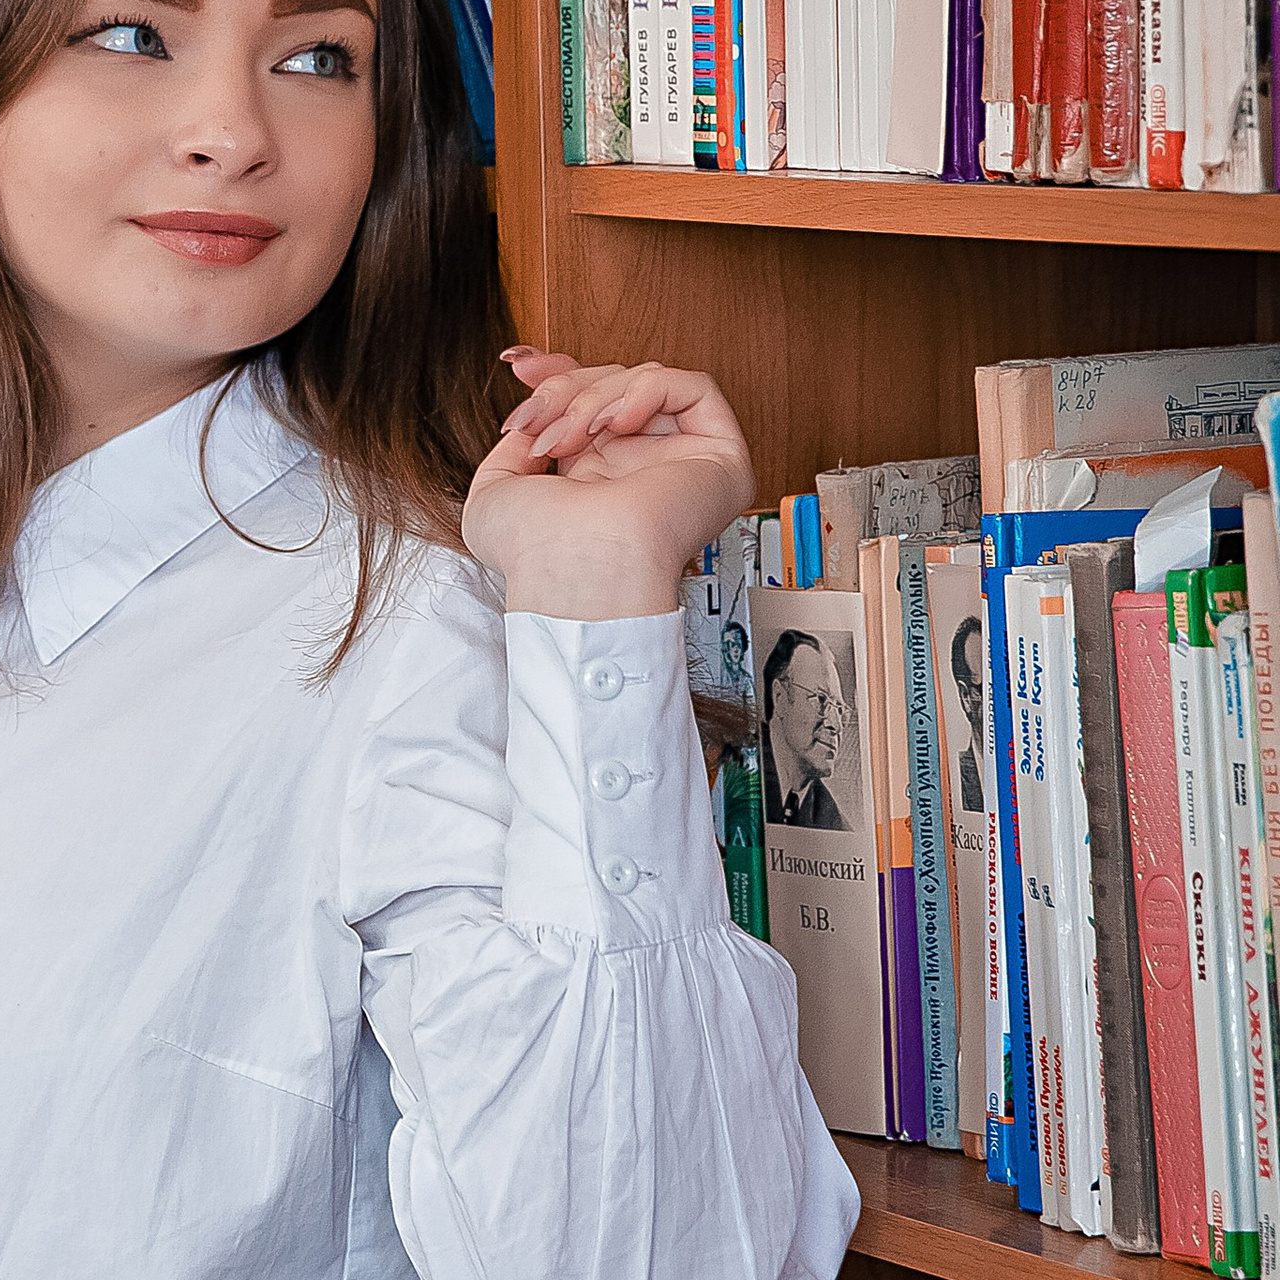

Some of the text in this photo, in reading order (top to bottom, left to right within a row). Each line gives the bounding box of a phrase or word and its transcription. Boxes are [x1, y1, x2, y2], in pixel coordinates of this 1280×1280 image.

[559, 6, 573, 131] ХРЕСТОМАТИЯ
[1150, 85, 1166, 157] ОНИКС
[907, 570, 932, 721] Ханский ярлык
[1017, 636, 1031, 775] Эллис Каут
[1031, 642, 1045, 782] Эллис Каут
[914, 730, 936, 792] улицы
[1261, 747, 1279, 795] БЕЗ
[915, 798, 939, 887] Холопьей
[1184, 769, 1199, 847] Киплинг
[770, 847, 865, 881] Изюмский
[987, 811, 998, 917] РАССКАЗЫ
[1239, 847, 1257, 963] КНИГА
[799, 904, 835, 932] Б.В.
[921, 899, 940, 987] Тимофей
[1191, 871, 1208, 982] Сказки
[988, 938, 1000, 1001] ВОЙНЕ
[926, 997, 951, 1131] Борис Изюмский
[1017, 911, 1037, 1152] ХРЕСТОМАТИЯ ШКОЛЬНИКА
[1038, 1035, 1052, 1109] Пумукль
[1053, 1044, 1065, 1118] Пумукль
[988, 1092, 999, 1160] ОНИКС
[1212, 1189, 1225, 1262] ОНИКС
